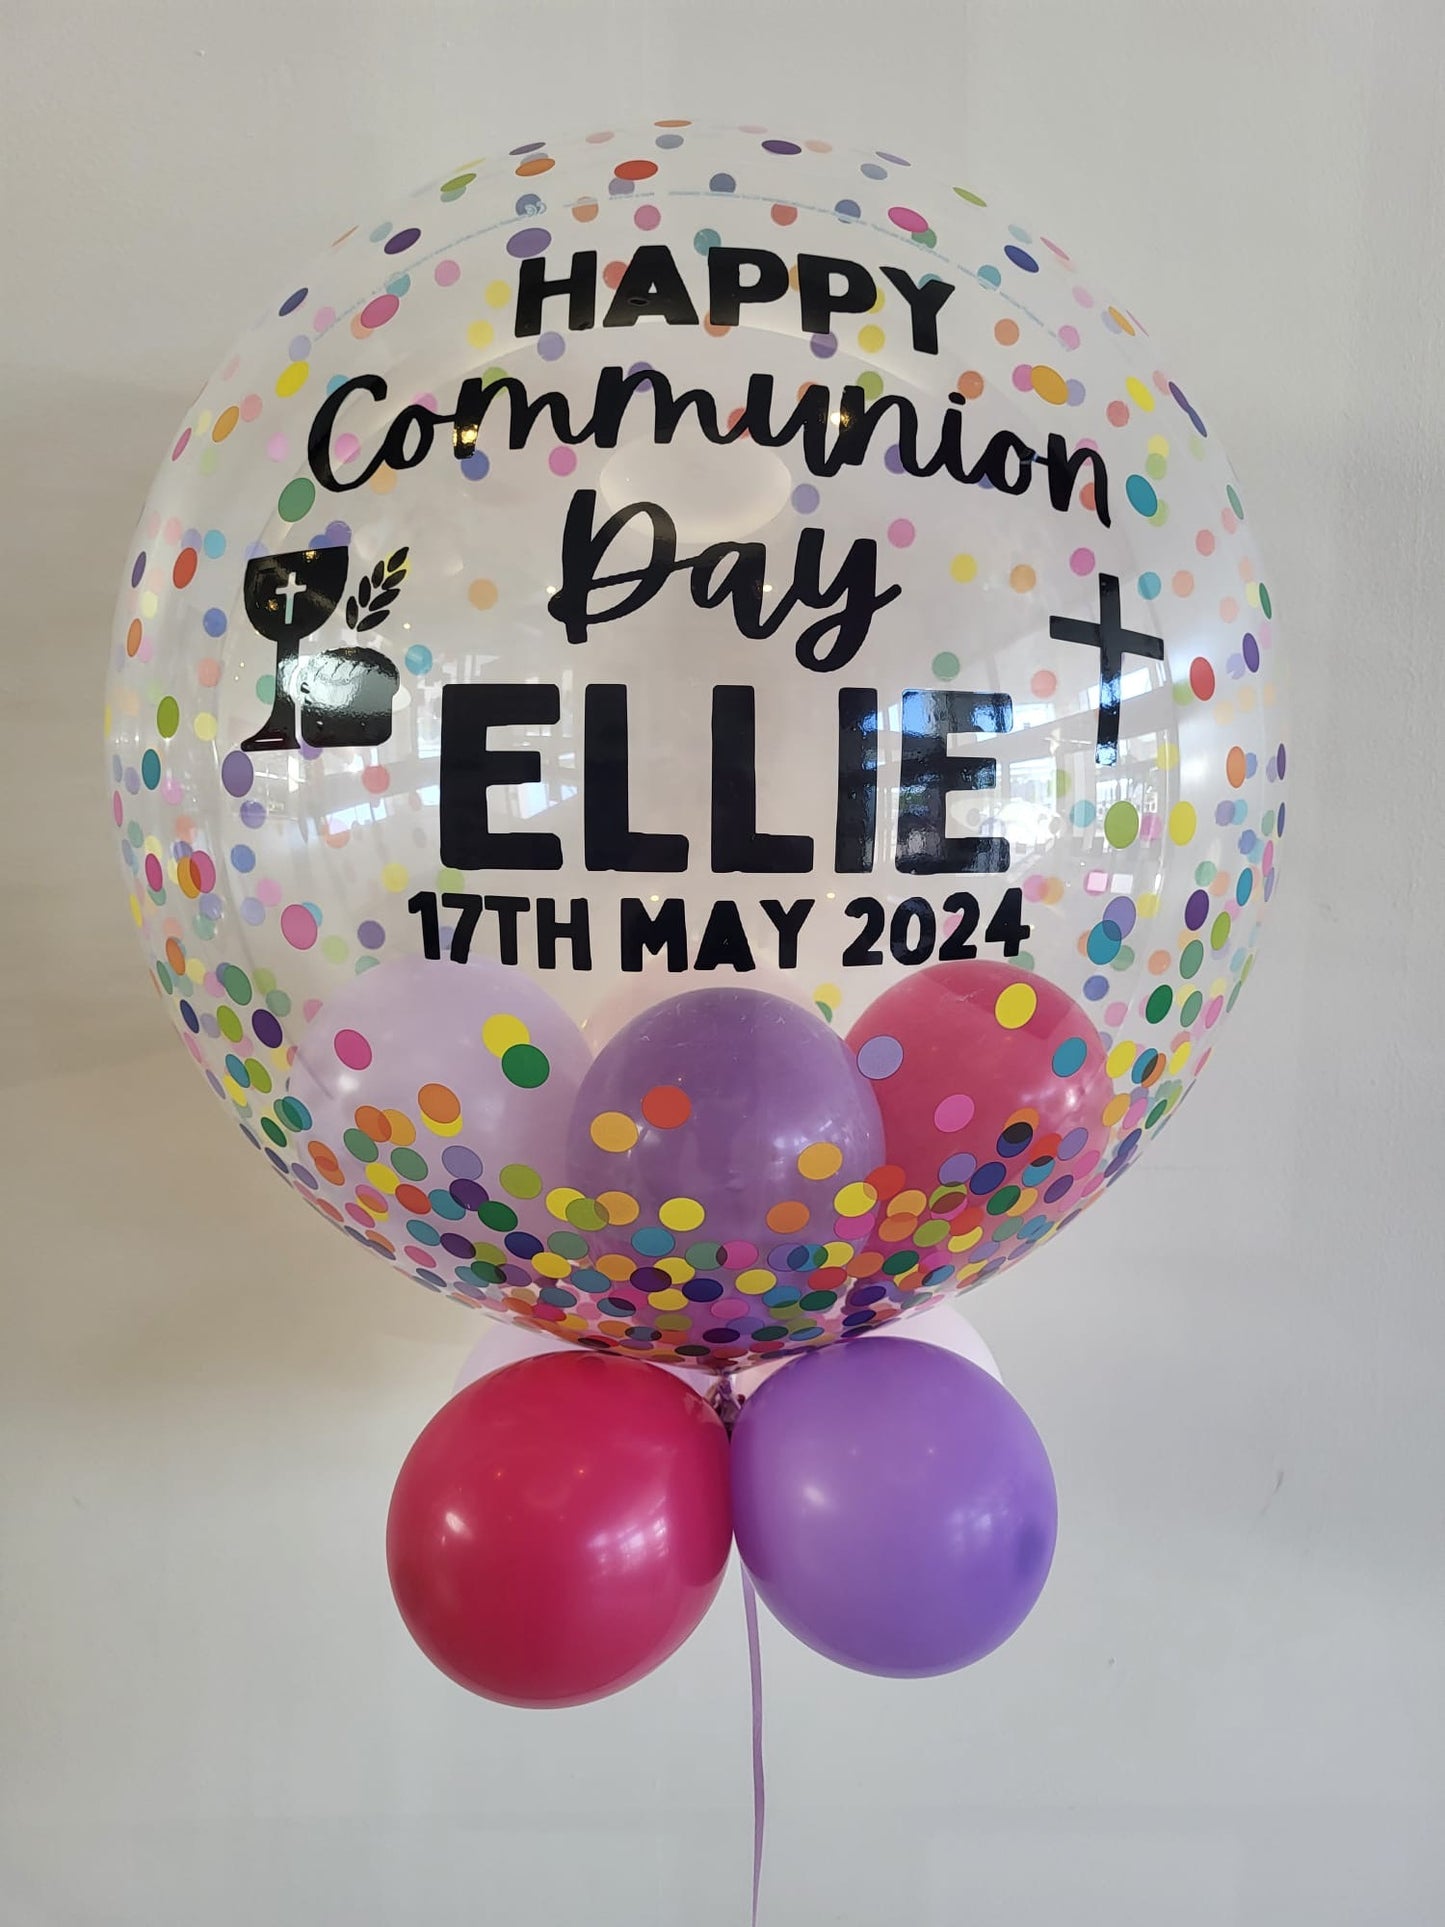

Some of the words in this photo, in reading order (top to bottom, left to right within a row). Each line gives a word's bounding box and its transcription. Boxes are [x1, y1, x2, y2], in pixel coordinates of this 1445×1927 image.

[514, 245, 956, 355] HAPPY
[307, 366, 1112, 529] Communion
[547, 489, 902, 673] Day
[439, 683, 1014, 876] ELLIE
[407, 890, 593, 971] 17TH
[620, 897, 817, 974] MAY
[842, 888, 1031, 967] 2024
